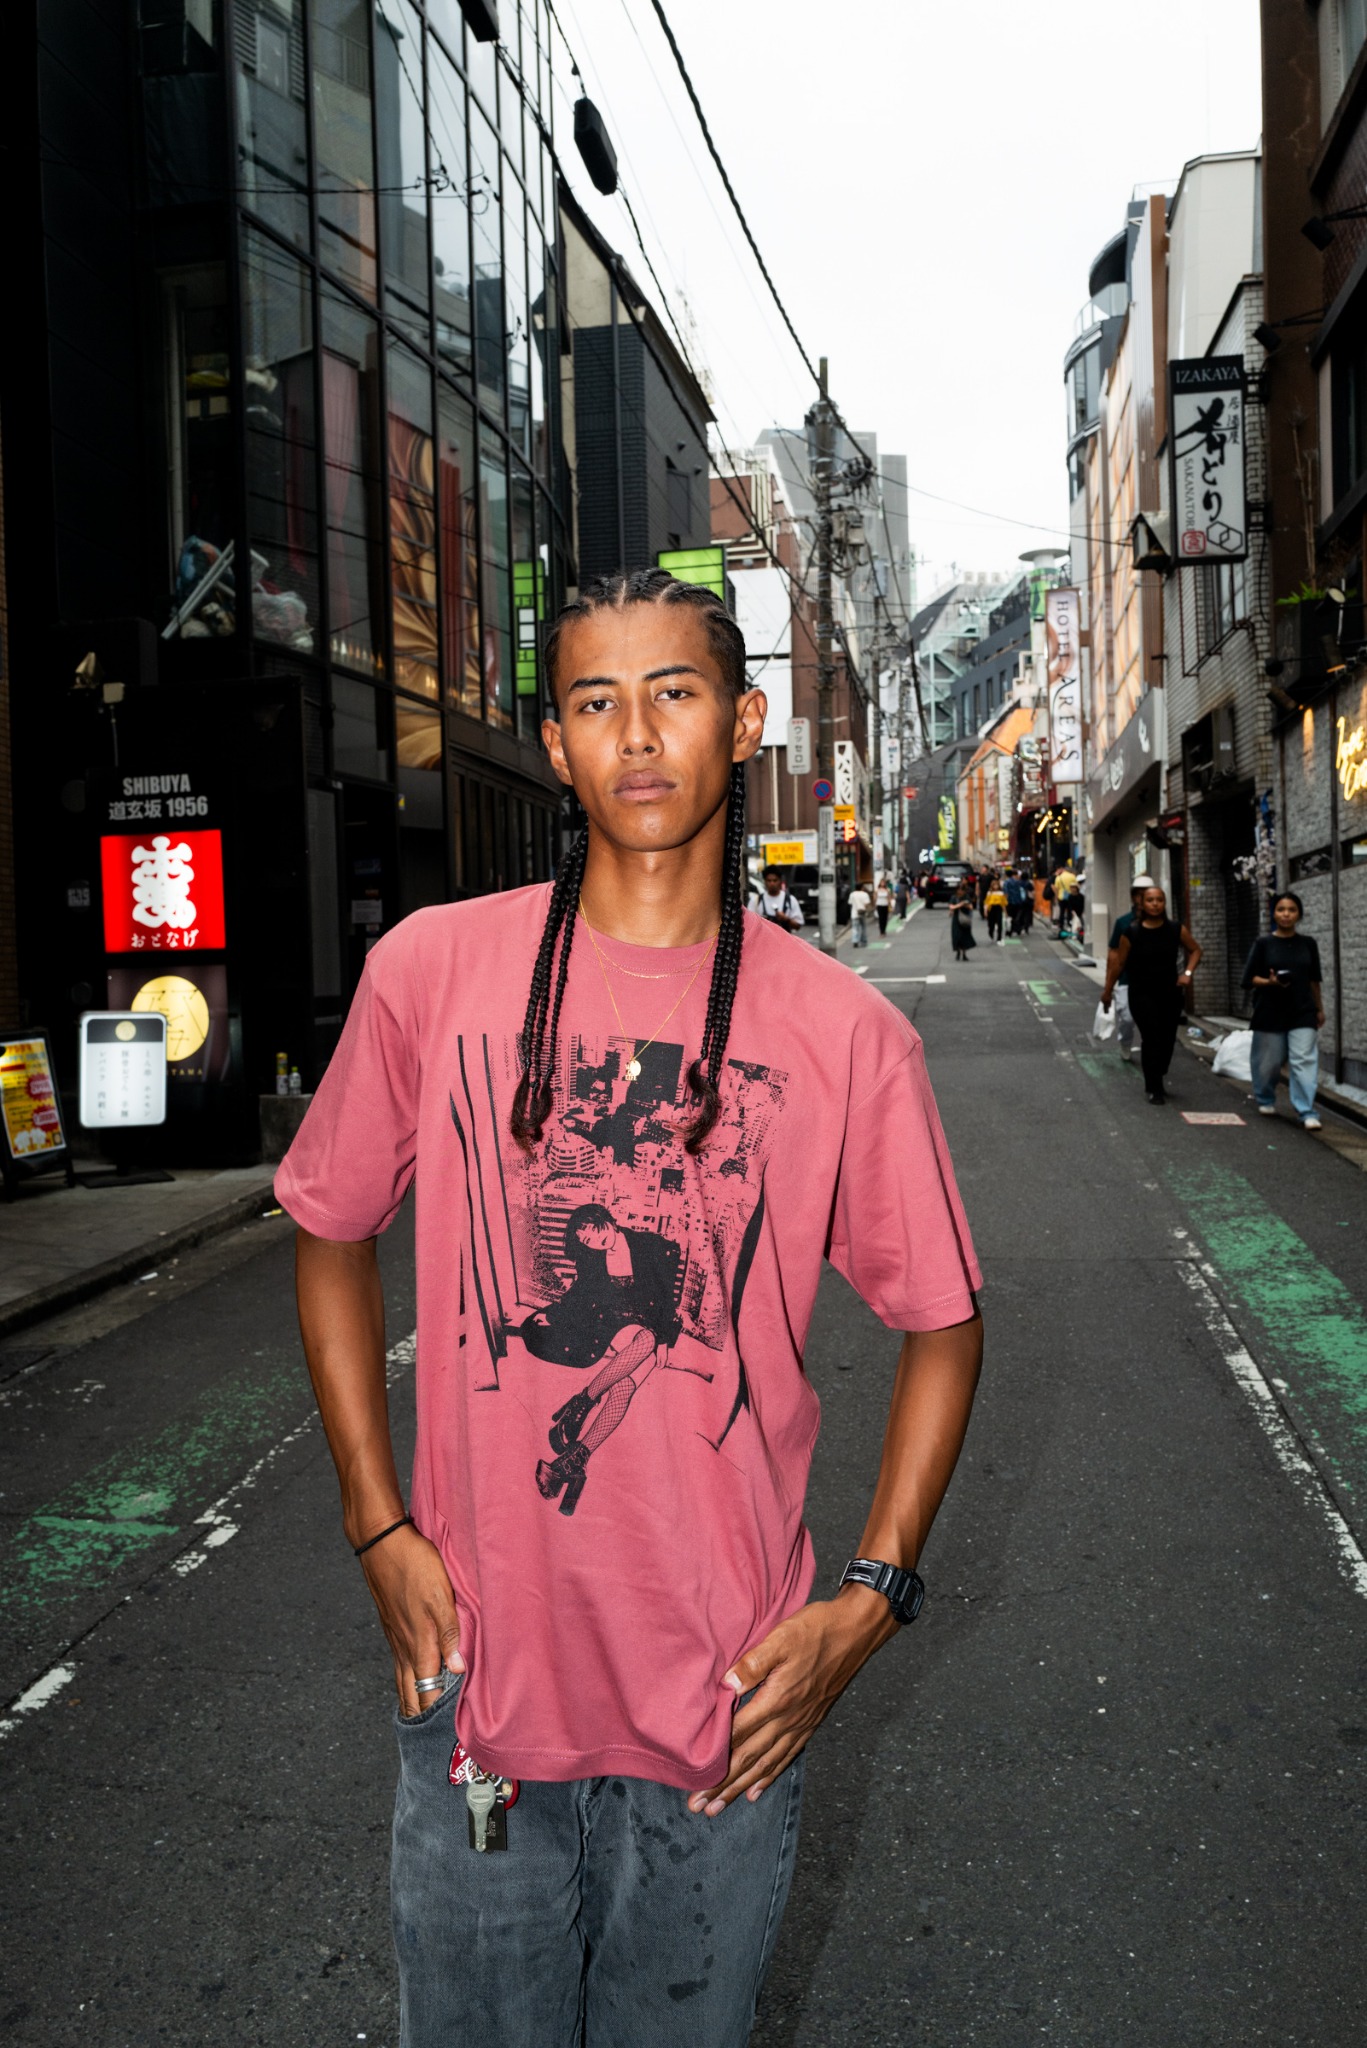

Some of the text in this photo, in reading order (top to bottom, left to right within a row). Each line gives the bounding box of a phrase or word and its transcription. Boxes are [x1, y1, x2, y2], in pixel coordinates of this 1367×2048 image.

[1176, 366, 1240, 384] IZAKAYA
[1056, 600, 1080, 764] HOTEL AREAS
[122, 773, 191, 796] SHIBUYA
[108, 796, 208, 821] 道玄坂 1956
[131, 929, 199, 948] おとなげ
